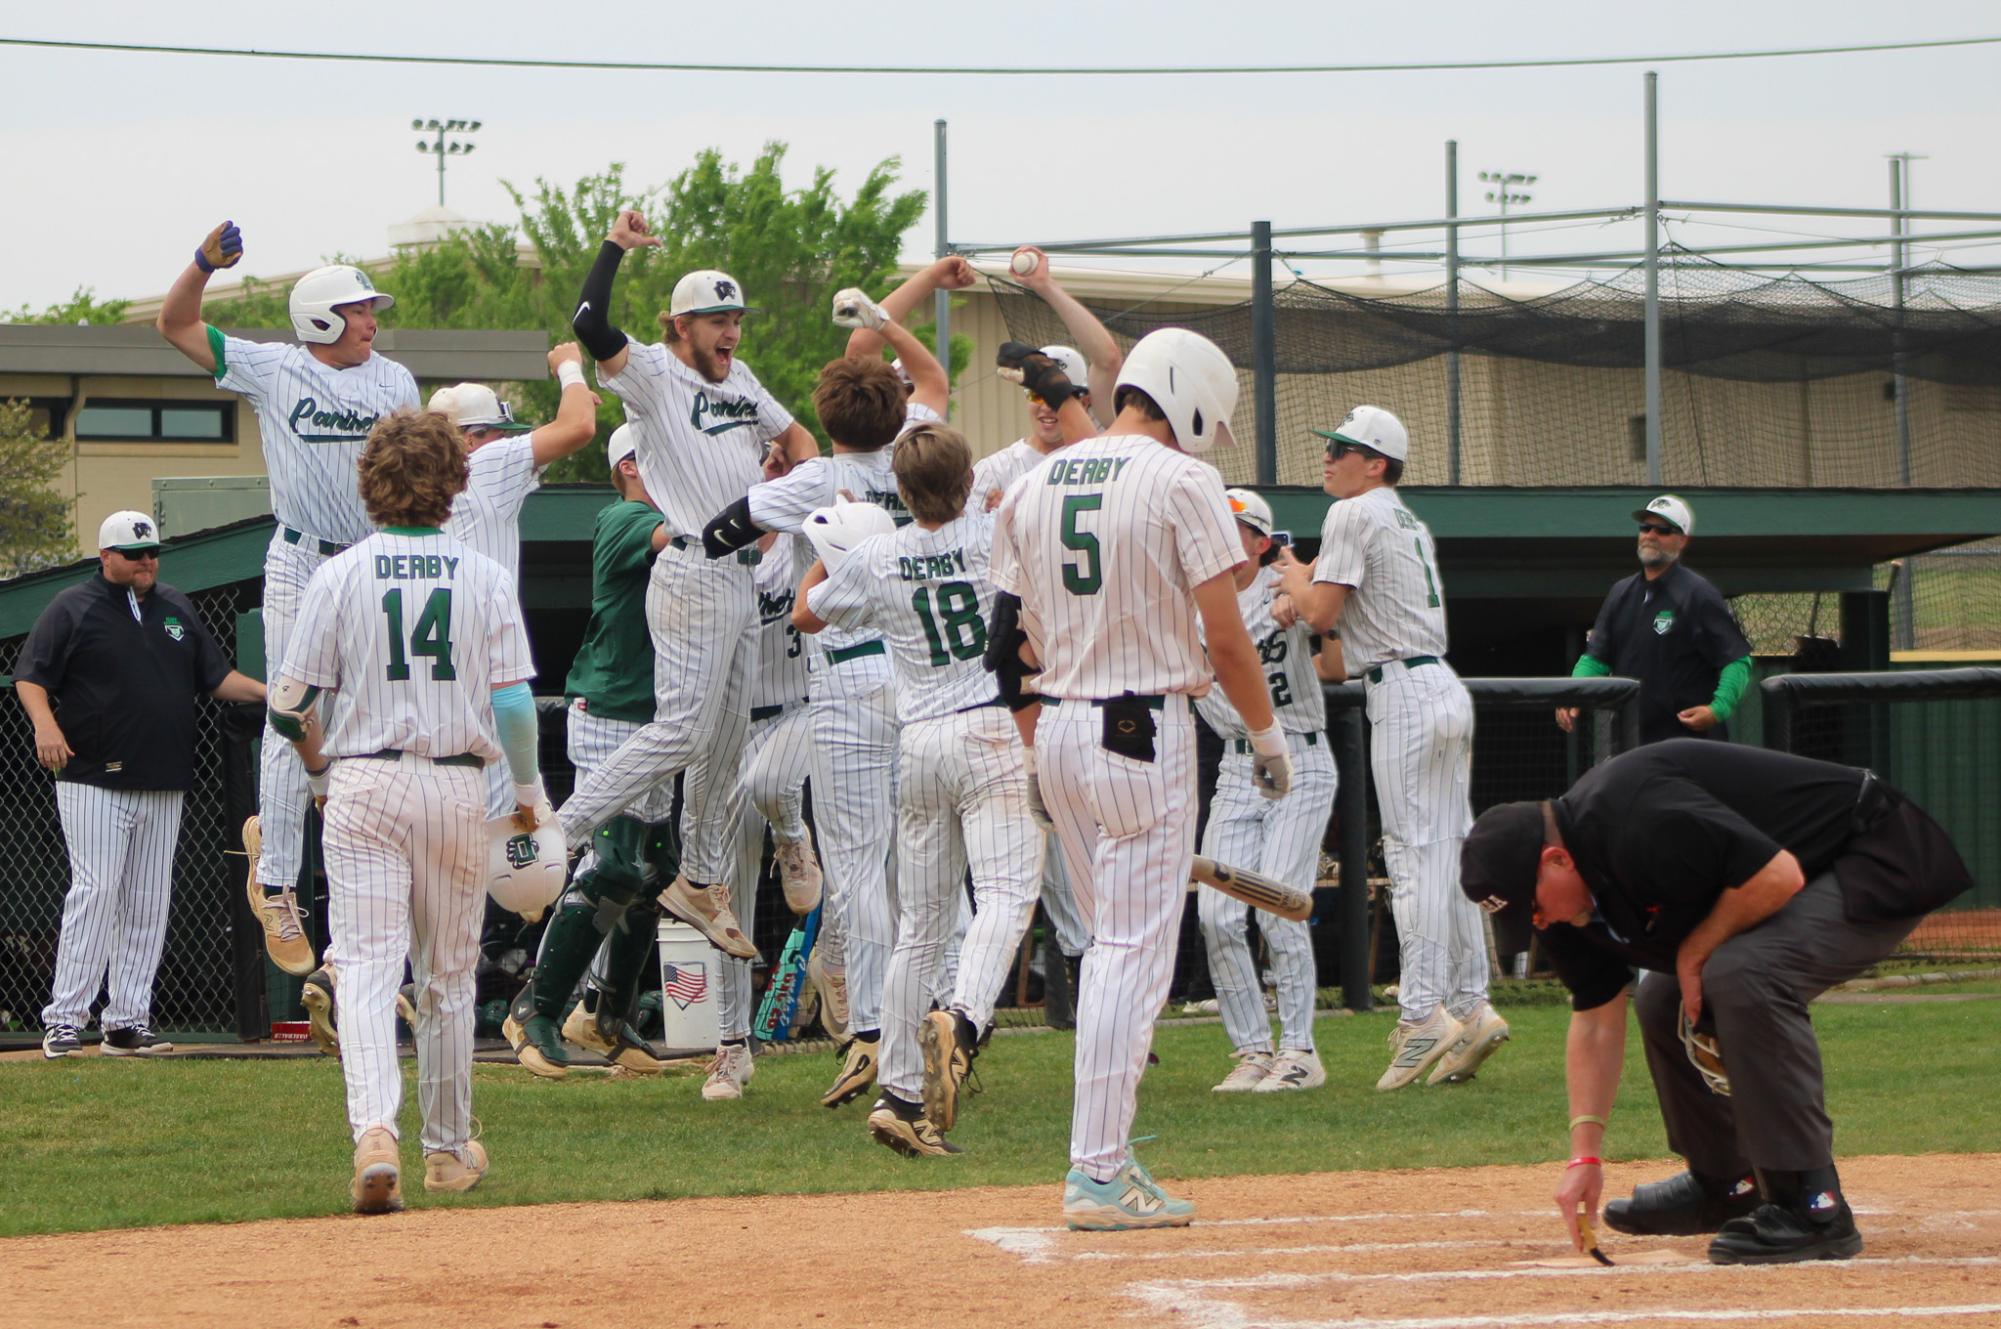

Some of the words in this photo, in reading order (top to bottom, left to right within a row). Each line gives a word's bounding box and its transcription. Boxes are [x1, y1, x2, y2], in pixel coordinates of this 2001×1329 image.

[1047, 457, 1132, 485] DERBY
[1060, 493, 1103, 596] 5
[375, 554, 459, 580] DERBY
[898, 547, 966, 581] DERBY
[1414, 537, 1440, 608] 1
[382, 587, 456, 681] 14
[786, 624, 801, 659] 3
[912, 581, 988, 667] 18
[1118, 1185, 1165, 1213] N
